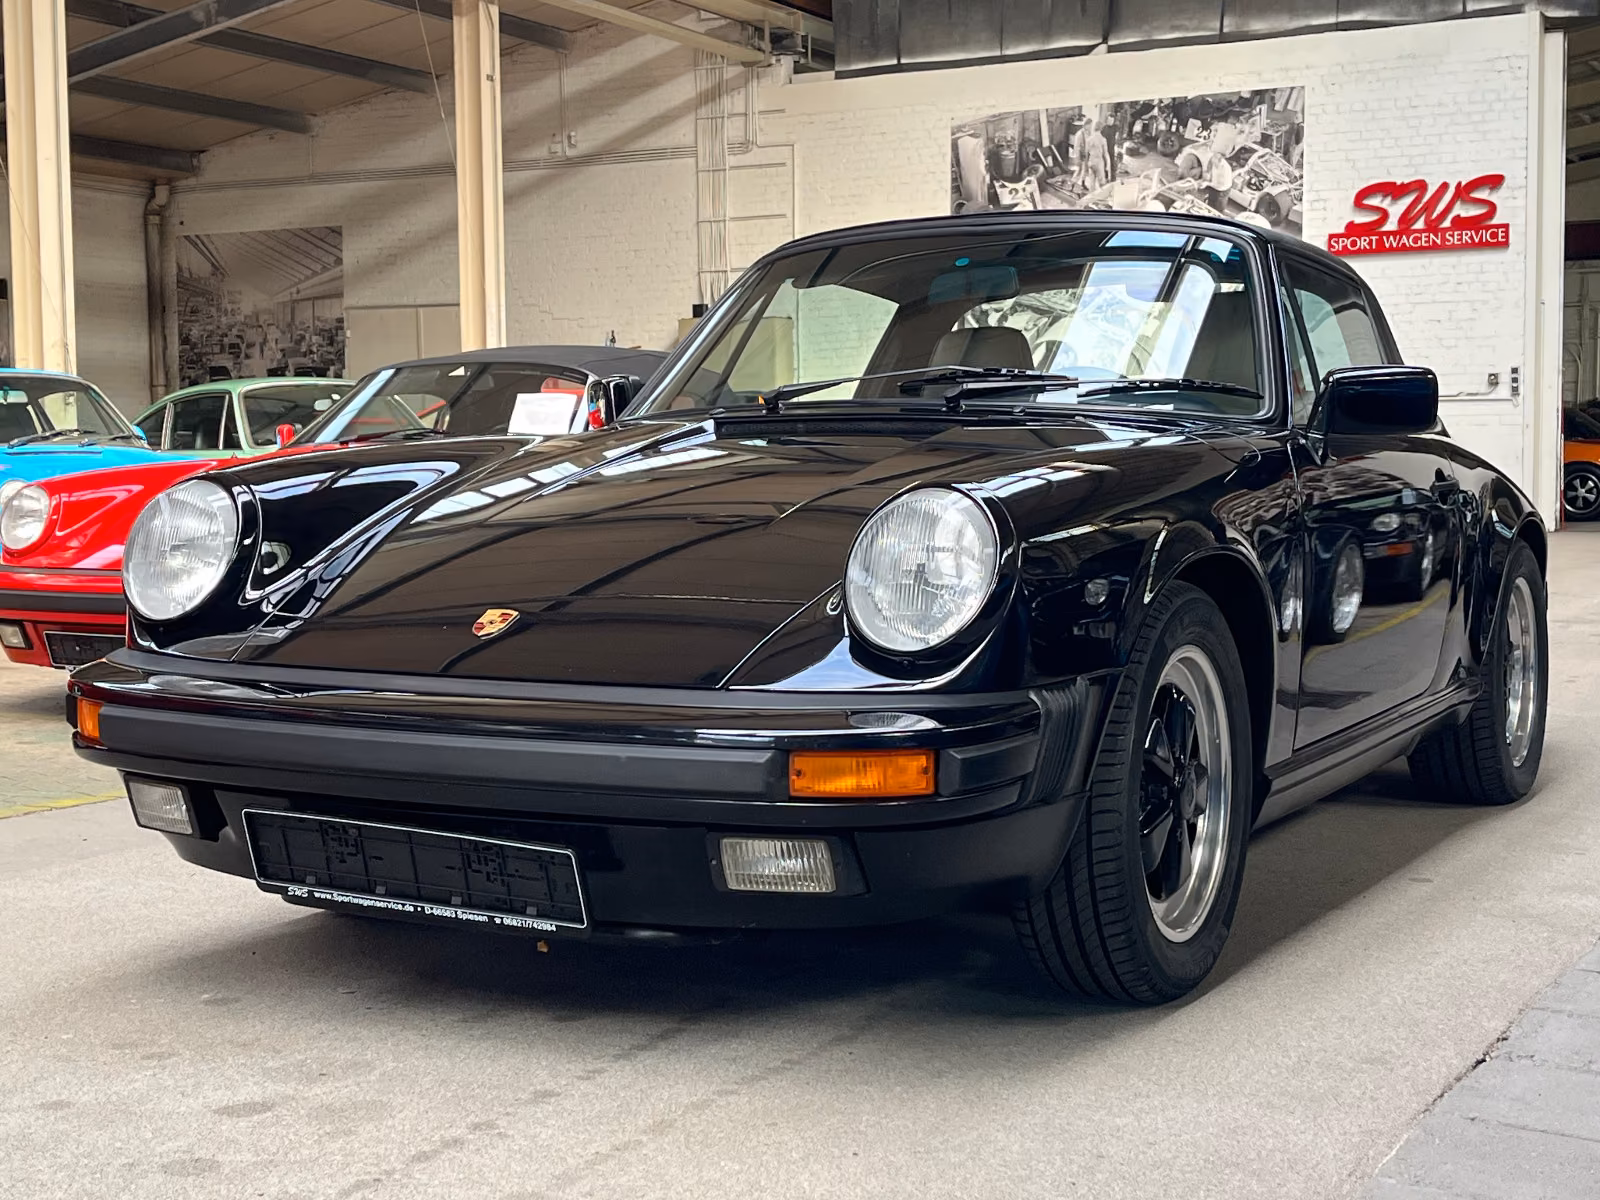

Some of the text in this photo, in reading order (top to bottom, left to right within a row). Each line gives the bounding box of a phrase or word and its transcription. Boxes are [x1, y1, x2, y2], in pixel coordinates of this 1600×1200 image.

[1345, 173, 1506, 233] SWS
[1330, 228, 1507, 252] SPORT WAGEN SERVICE
[287, 886, 309, 898] SWS
[313, 891, 415, 912] www.Sportwagenservice.de
